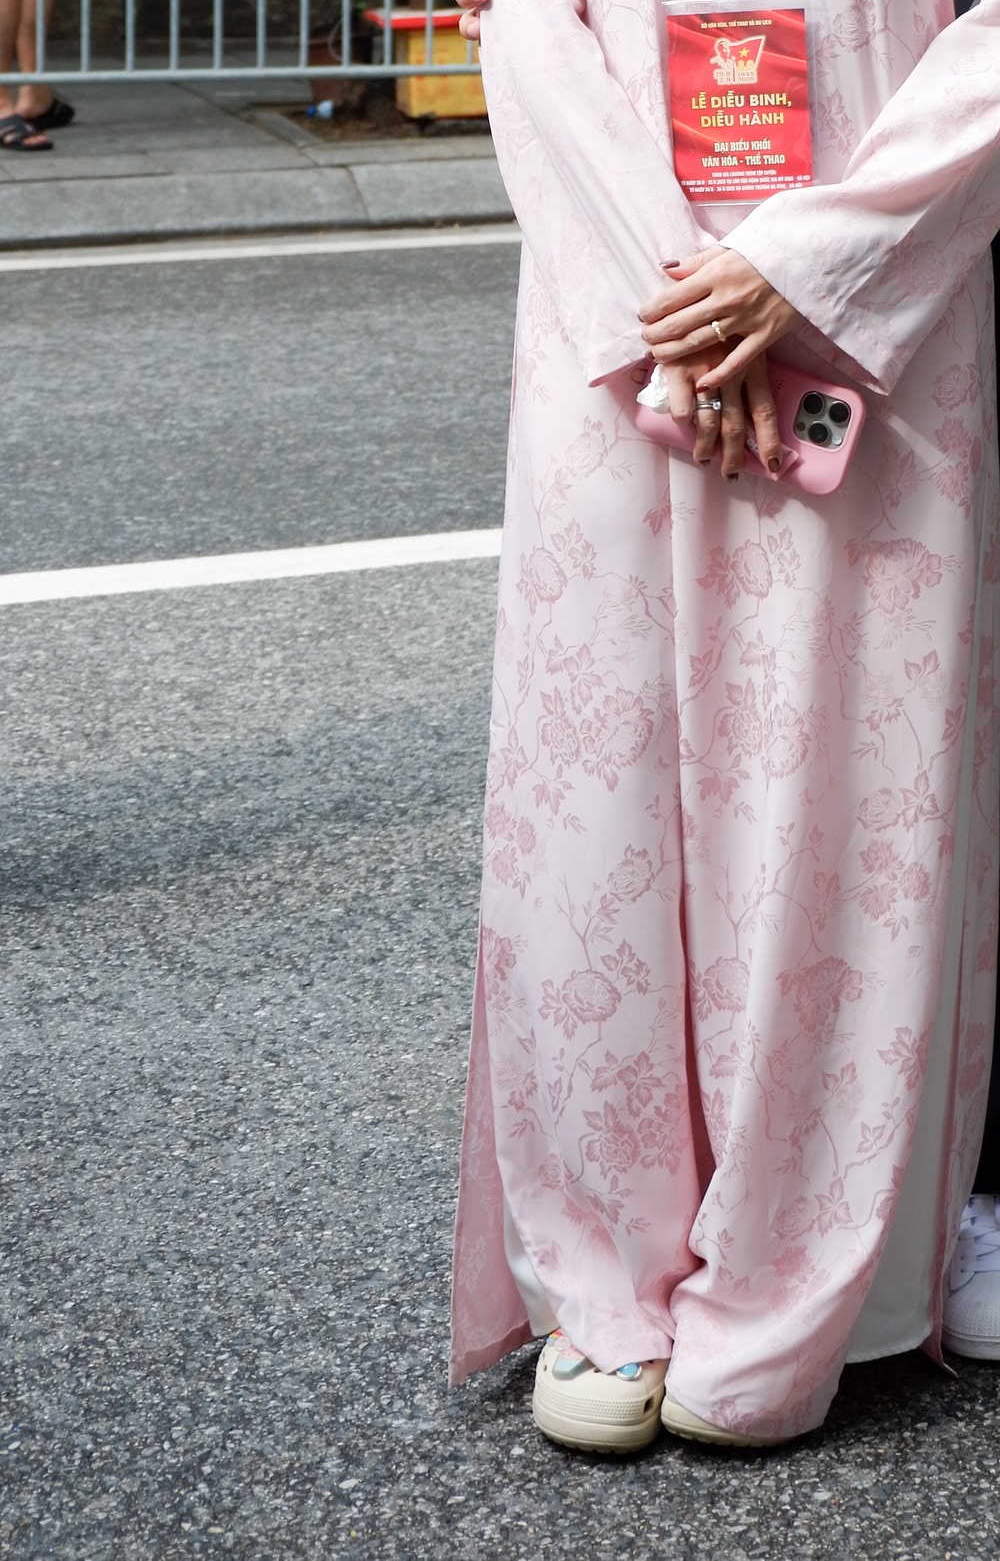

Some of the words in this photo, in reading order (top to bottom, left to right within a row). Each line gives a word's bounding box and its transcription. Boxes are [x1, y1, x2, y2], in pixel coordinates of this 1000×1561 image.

[691, 92, 707, 110] LỄ
[711, 90, 744, 109] DIỄU
[749, 93, 792, 107] BINH,
[700, 110, 734, 128] DIỄU
[739, 110, 784, 126] HÀNH
[714, 141, 729, 153] ĐẠI
[730, 138, 750, 151] BIỂU
[751, 138, 771, 150] KHỐI
[702, 157, 720, 167] VĂN
[745, 152, 762, 165] THỂ
[763, 155, 785, 164] THAO
